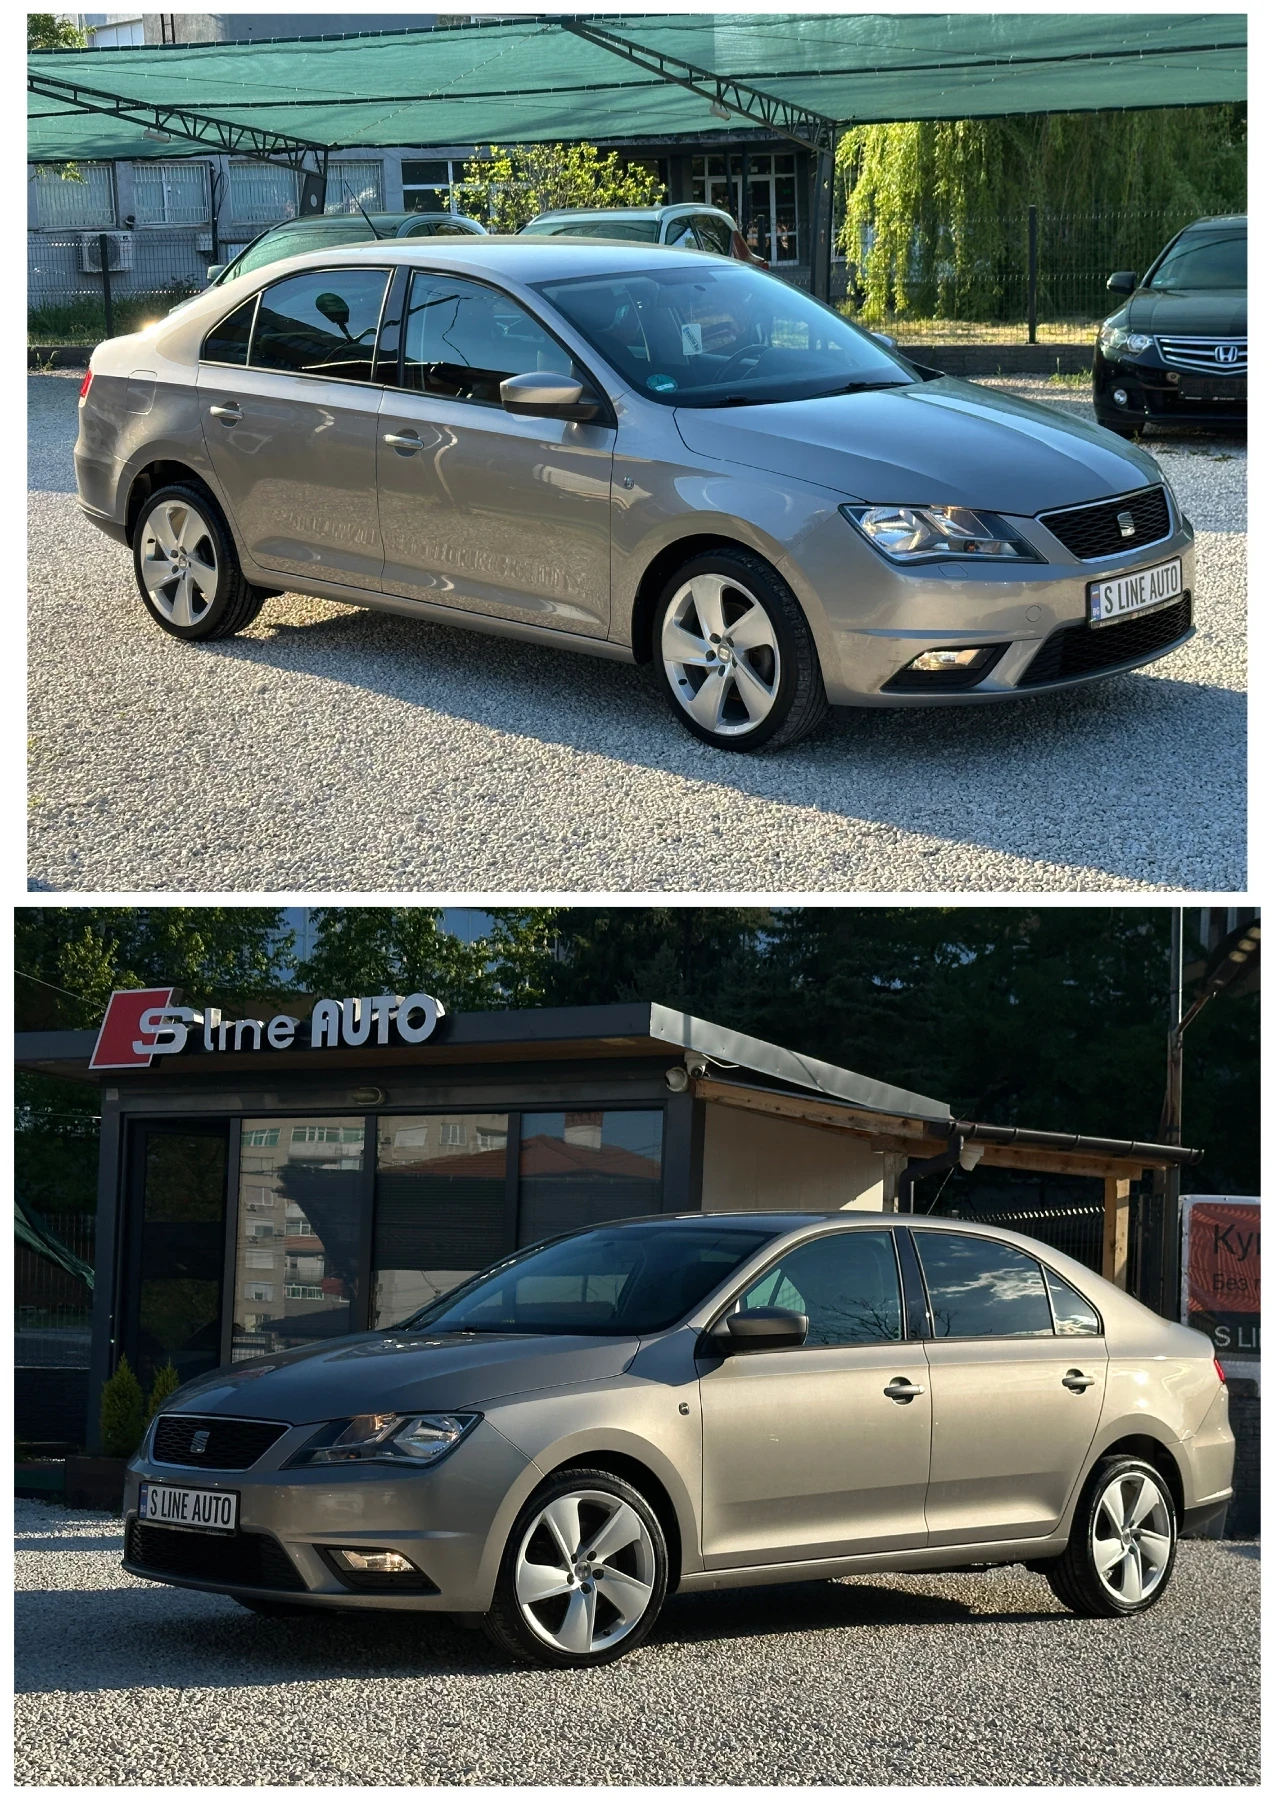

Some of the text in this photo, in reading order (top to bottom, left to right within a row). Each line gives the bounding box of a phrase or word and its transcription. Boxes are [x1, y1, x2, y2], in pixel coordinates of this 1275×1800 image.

[1104, 585, 1114, 614] S
[1117, 576, 1146, 610] LINE
[1149, 564, 1178, 601] AUTO
[132, 993, 438, 1055] S line AUTO
[1213, 1224, 1261, 1262] Ку
[1213, 1273, 1249, 1292] Без
[1214, 1325, 1261, 1348] S LI
[150, 1489, 232, 1525] S LINE AUTO
